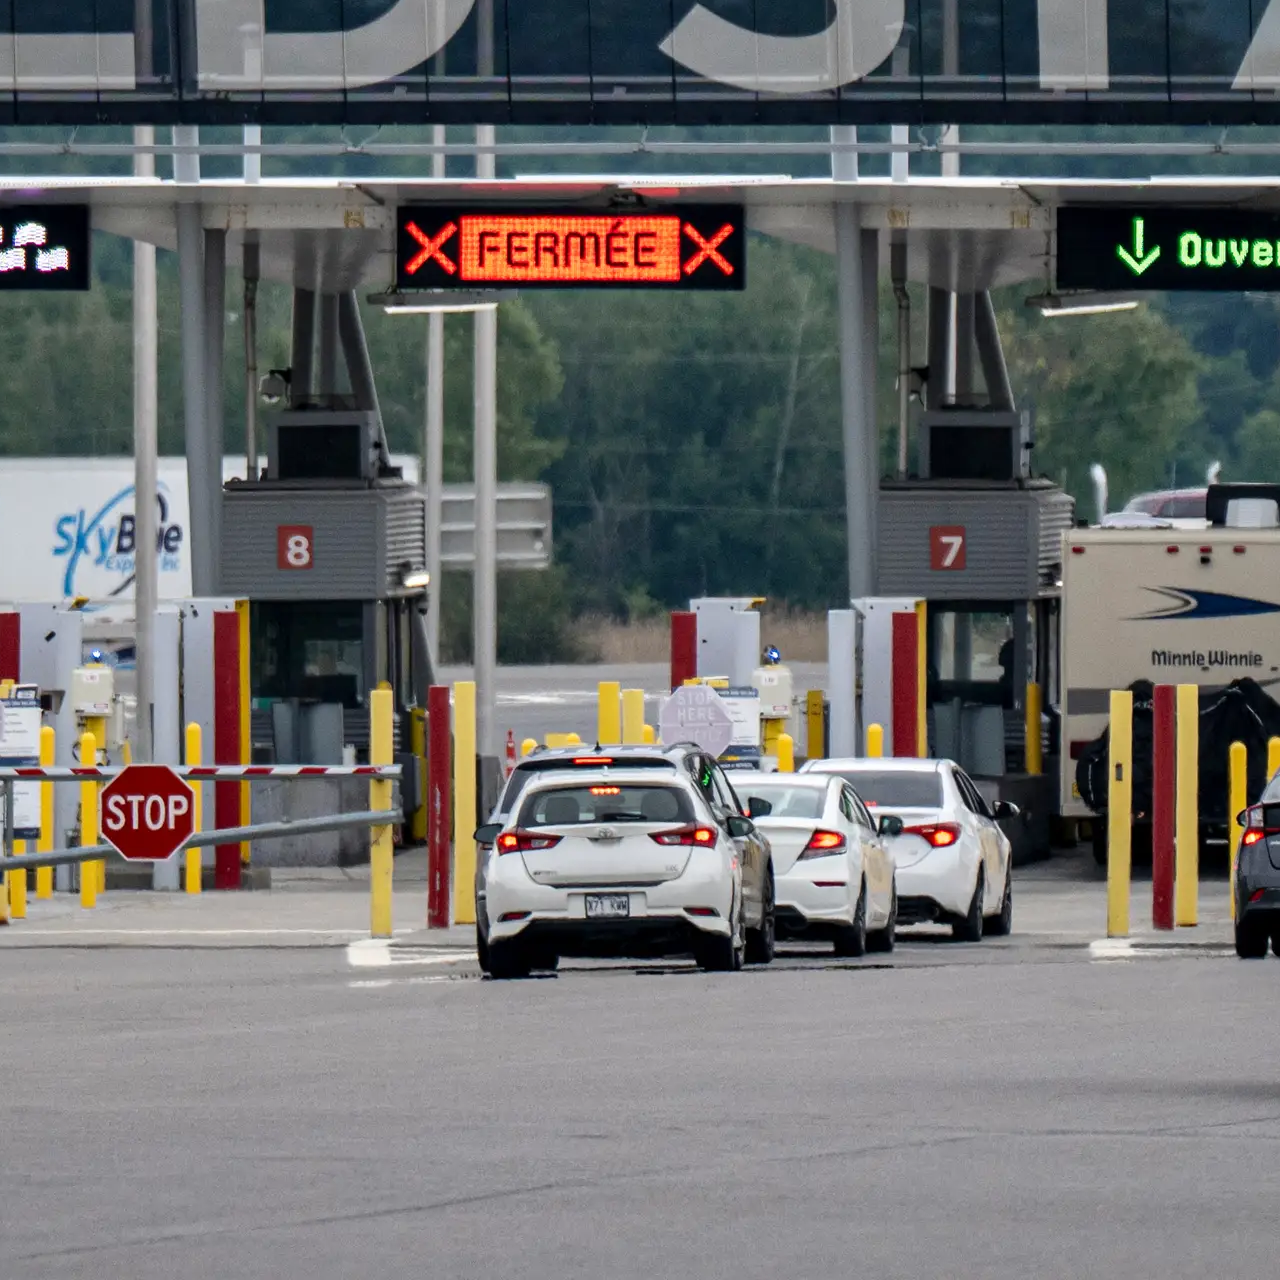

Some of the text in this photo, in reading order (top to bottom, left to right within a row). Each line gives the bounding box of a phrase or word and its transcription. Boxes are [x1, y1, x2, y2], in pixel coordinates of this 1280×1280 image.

[479, 221, 657, 267] FERMÉE
[287, 535, 310, 566] 8
[940, 535, 963, 567] 7
[1152, 650, 1263, 667] Minnie Winnie
[677, 692, 712, 706] STOP
[677, 707, 716, 720] HERE
[106, 794, 188, 831] STOP
